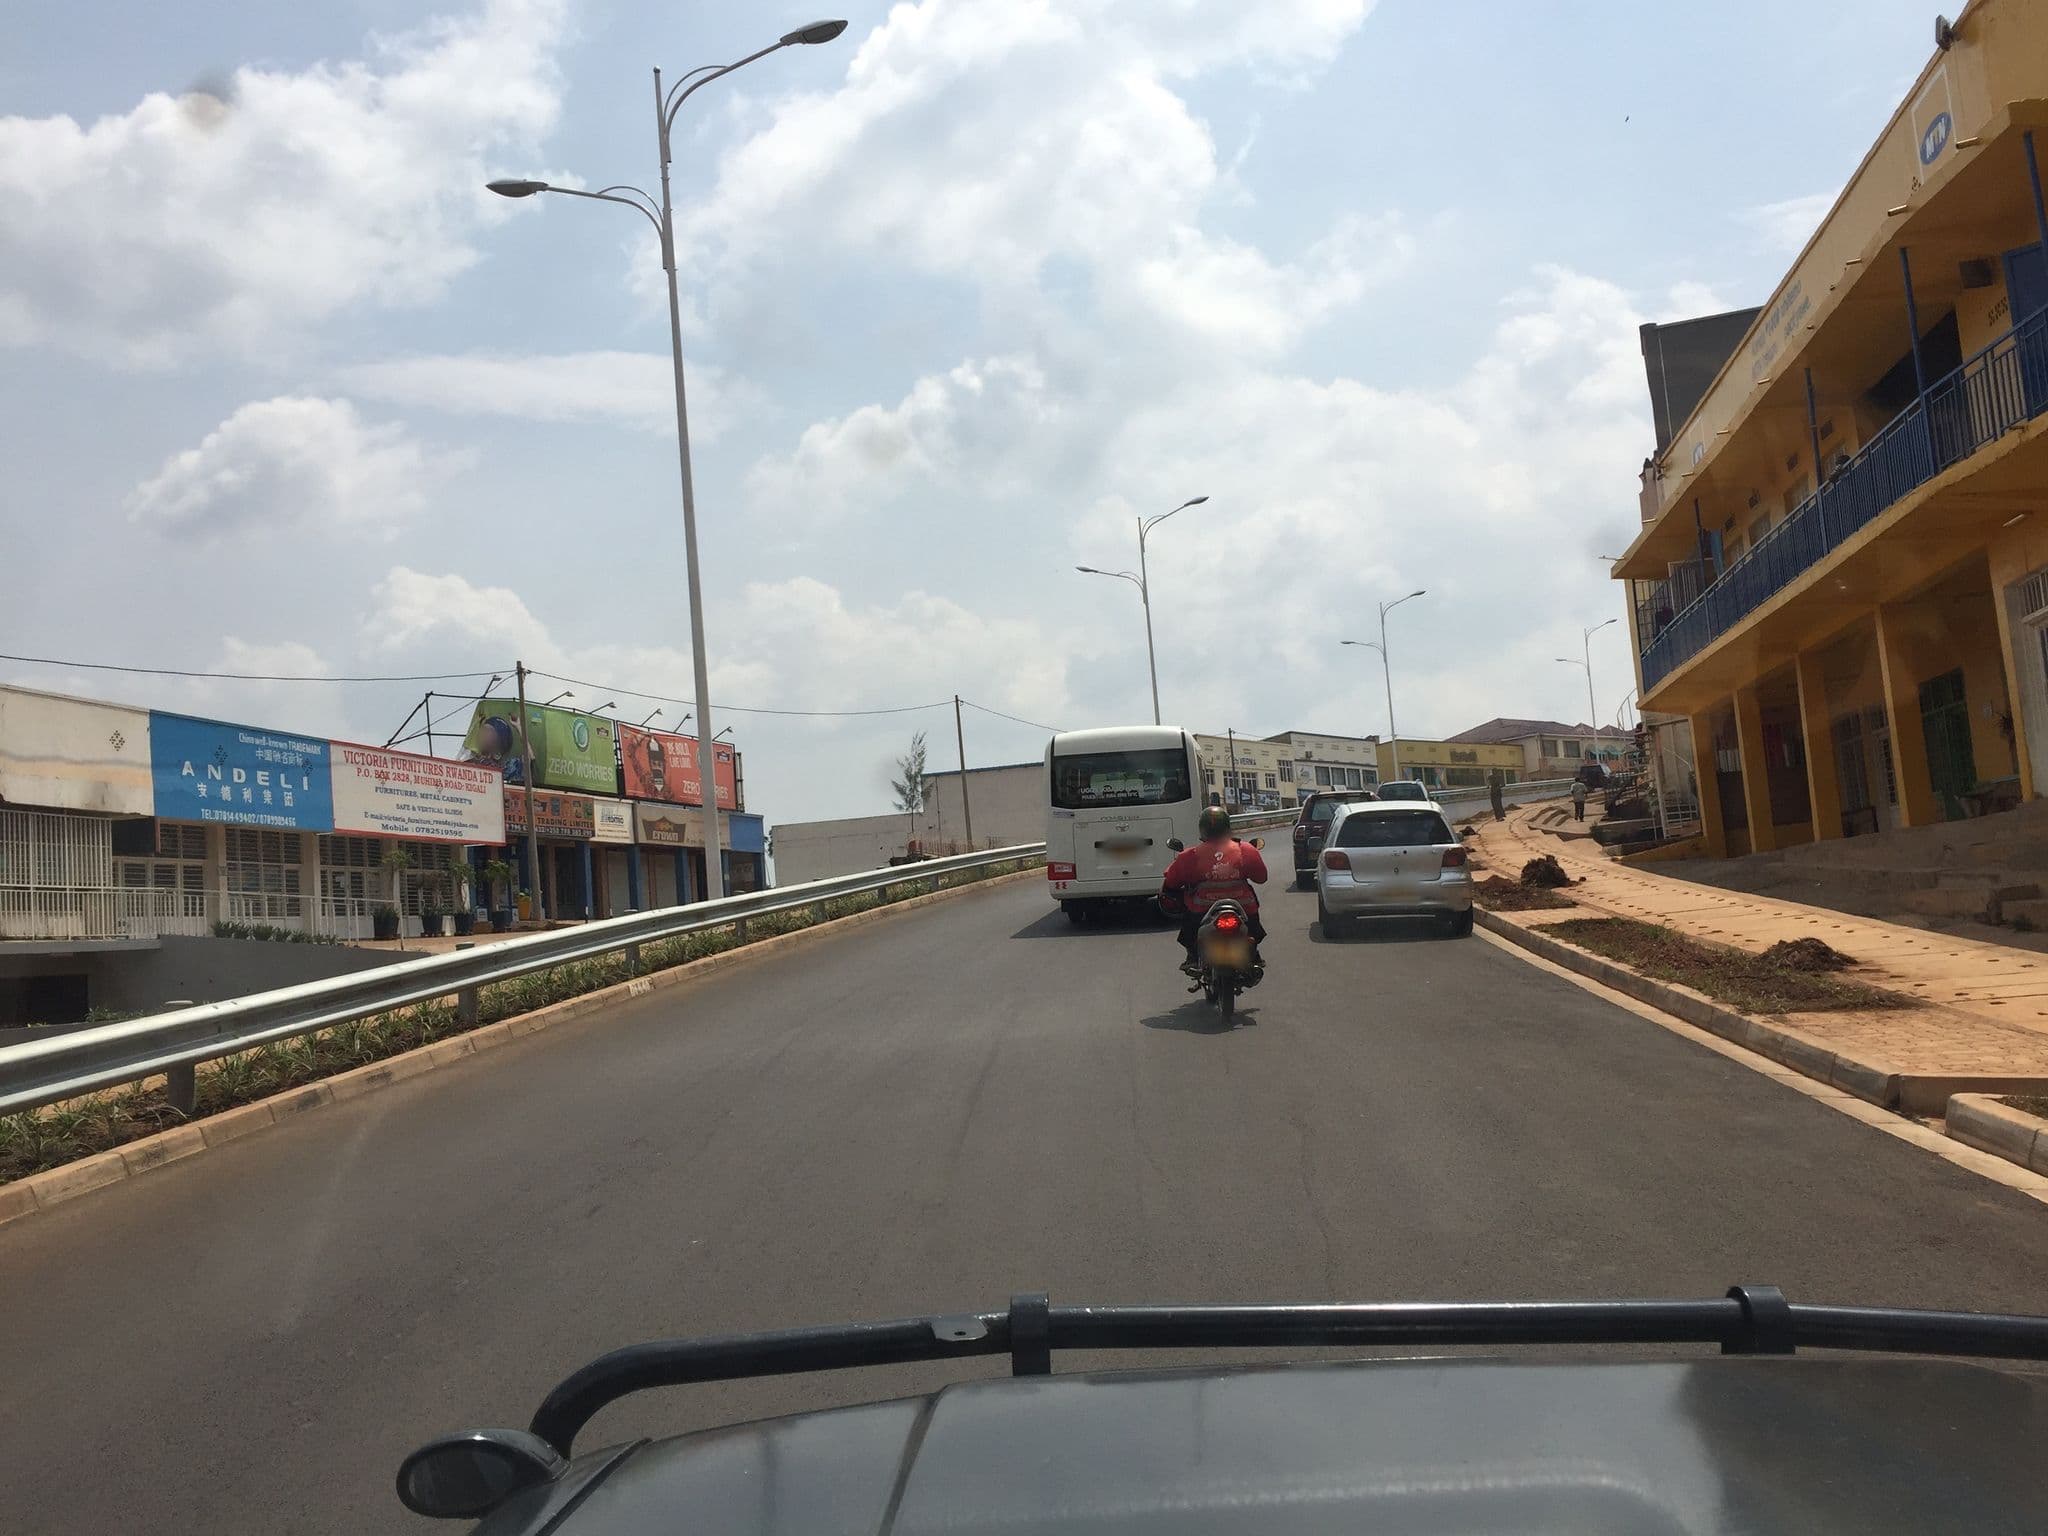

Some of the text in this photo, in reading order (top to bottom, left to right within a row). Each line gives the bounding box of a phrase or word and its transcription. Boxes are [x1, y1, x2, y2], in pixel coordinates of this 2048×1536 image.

[1925, 117, 1946, 160] MTN
[343, 750, 494, 784] VICTORIA FURNITURES RWANDA LTD
[548, 758, 613, 782] ZERO WORRIES
[465, 783, 486, 794] KIGALI
[683, 780, 701, 796] ZERO
[381, 823, 409, 833] Mobile
[537, 817, 567, 826] TRADING
[569, 819, 593, 828] LIMITED
